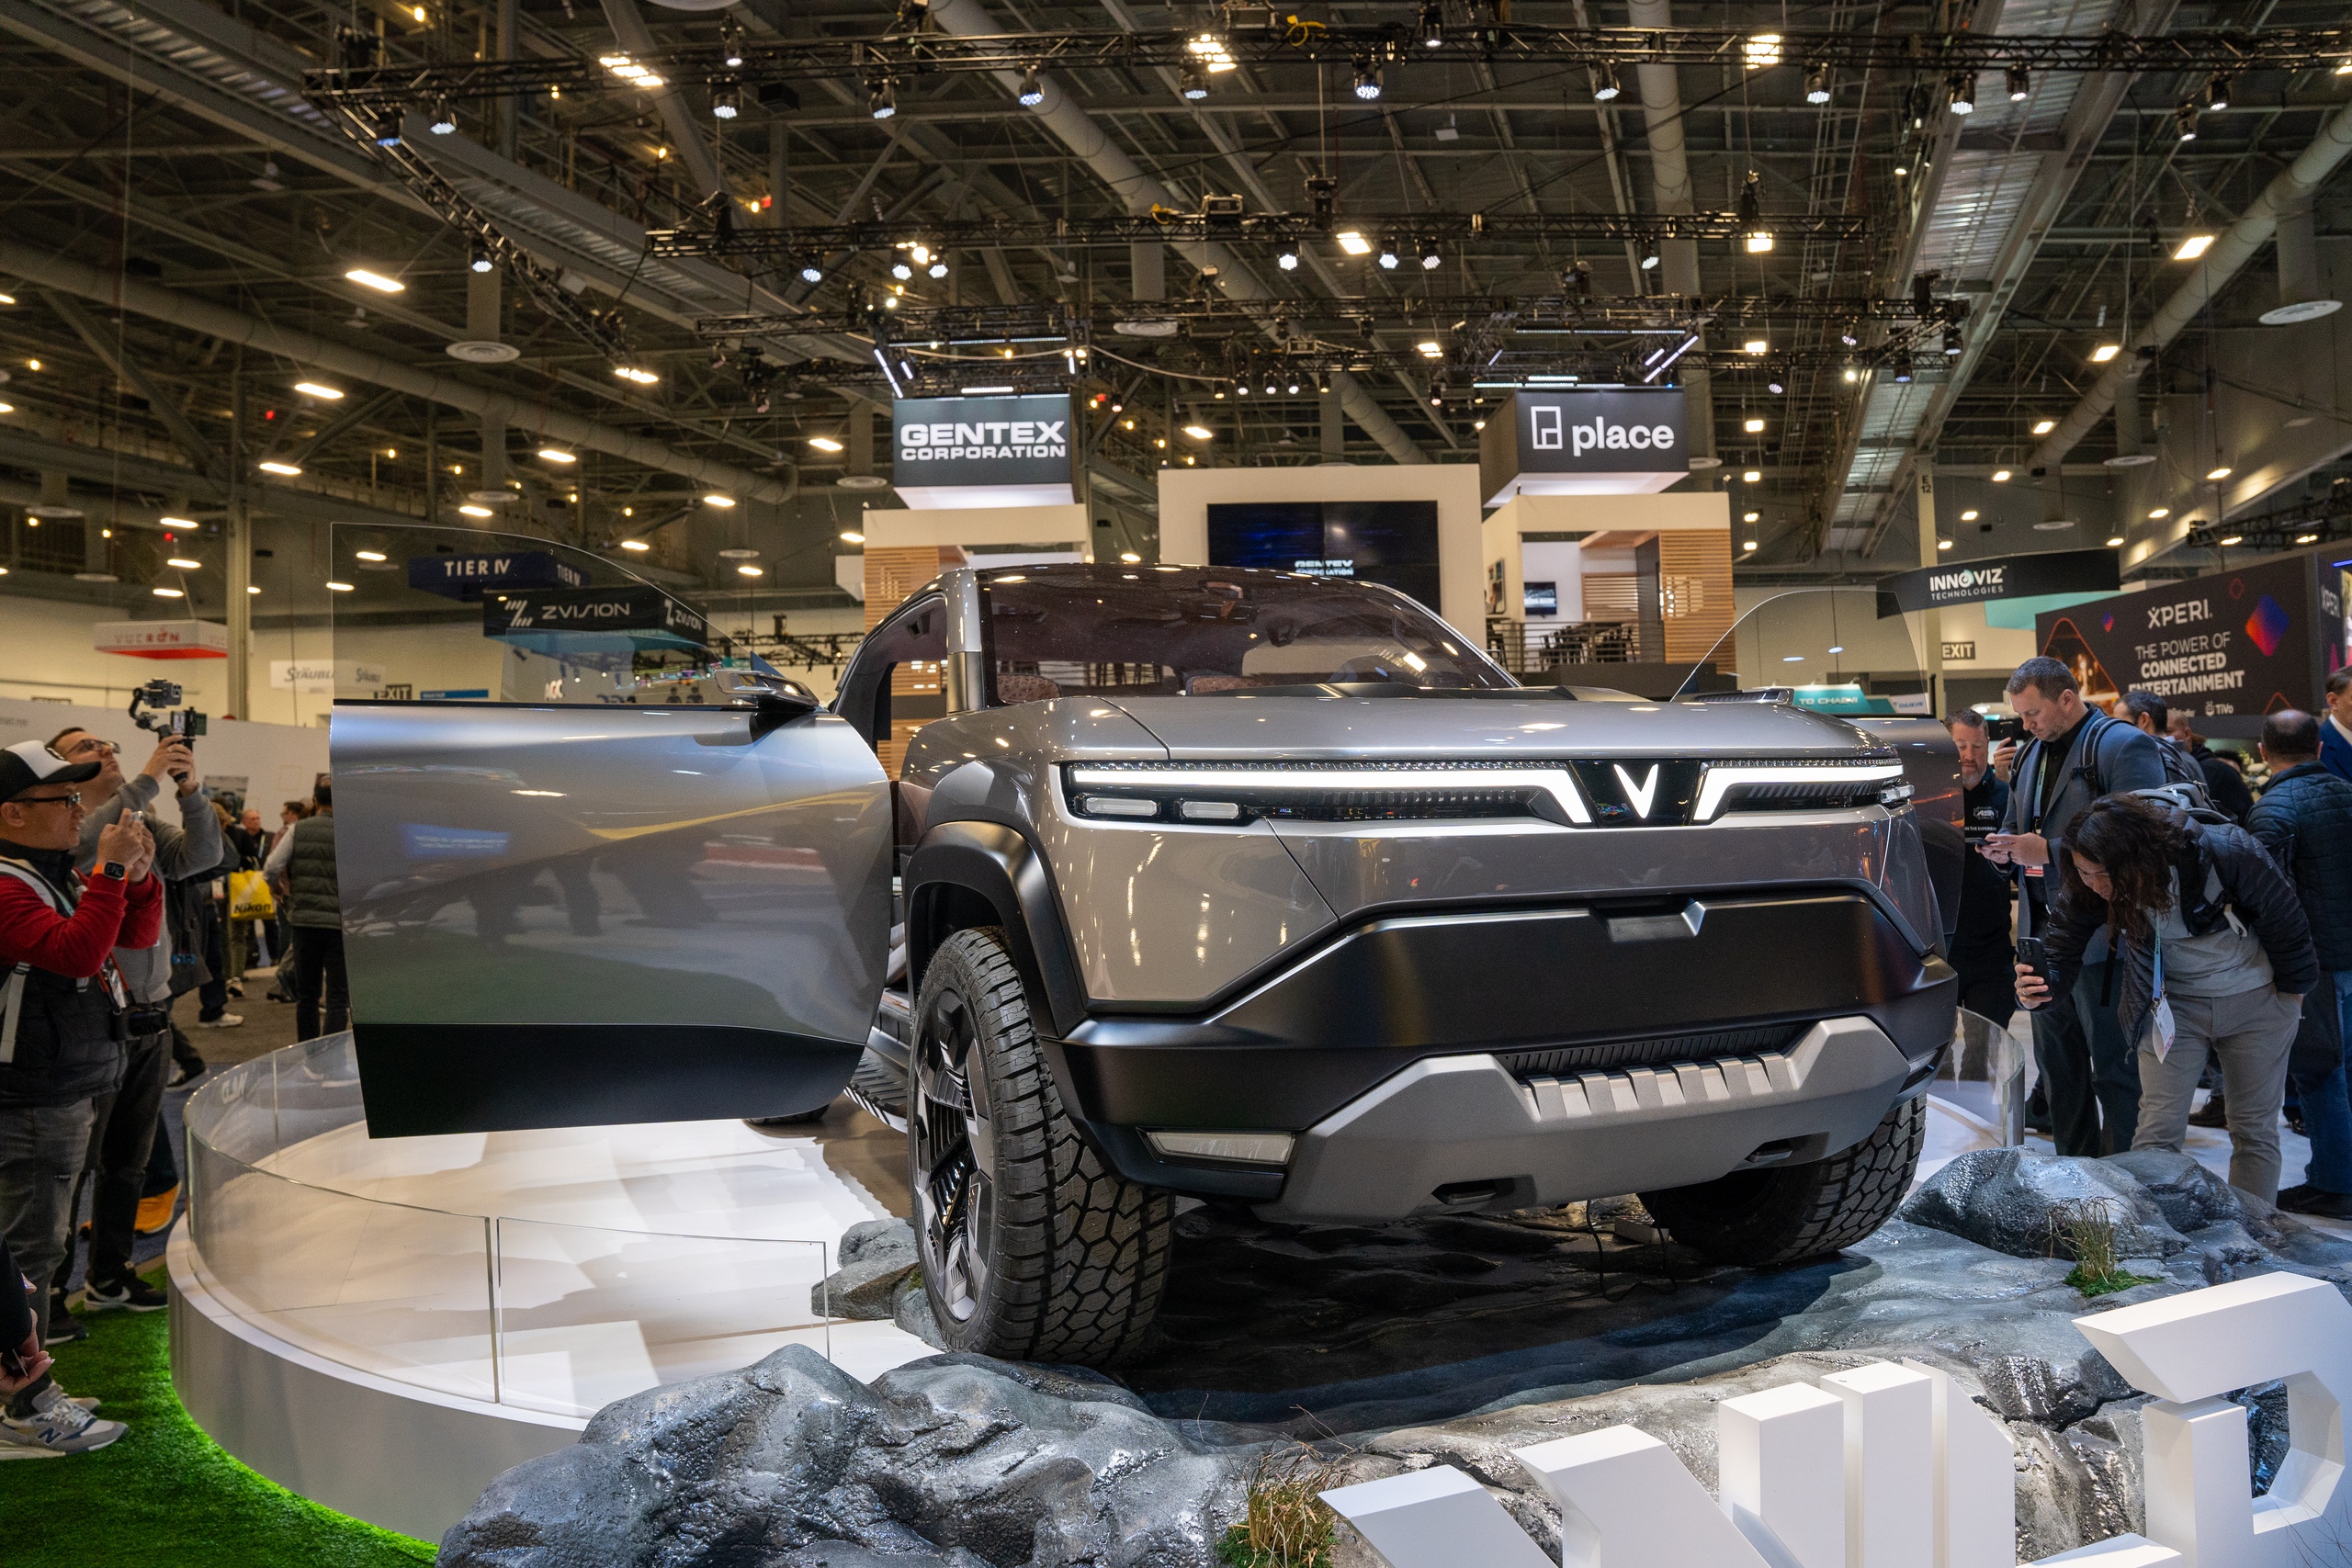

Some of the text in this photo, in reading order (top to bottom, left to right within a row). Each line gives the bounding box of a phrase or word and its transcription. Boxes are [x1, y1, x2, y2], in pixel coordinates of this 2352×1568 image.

[899, 421, 1066, 447] GENTEX
[1572, 415, 1675, 457] place
[901, 445, 1066, 461] CORPORATION
[445, 559, 489, 577] TIER
[1930, 568, 2004, 592] INNOVIZ
[1931, 584, 2004, 601] TECHNOLOGIES
[542, 602, 630, 619] ZVISION
[1942, 644, 1973, 659] EXIT
[2135, 631, 2231, 660] THE POWER OF
[2141, 651, 2227, 679] CONNECTED
[234, 902, 272, 914] Nikon
